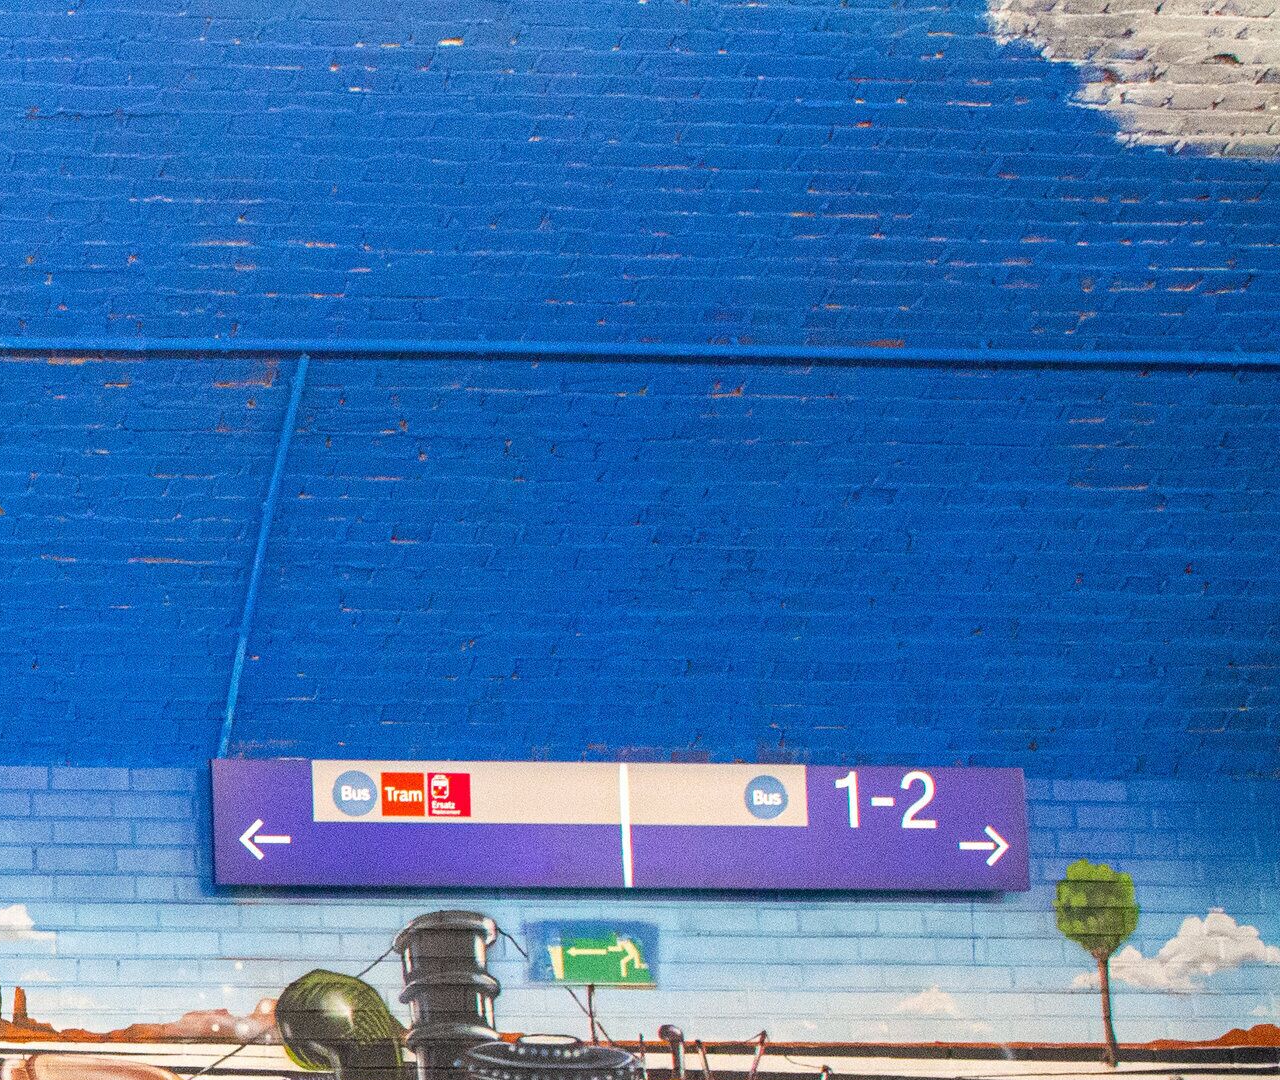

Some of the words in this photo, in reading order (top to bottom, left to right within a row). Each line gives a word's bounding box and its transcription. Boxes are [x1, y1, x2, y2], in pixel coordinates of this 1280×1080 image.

[341, 785, 371, 801] Bus
[384, 786, 423, 802] Tram
[752, 789, 783, 806] Bus
[834, 770, 939, 829] 1-2
[431, 801, 456, 809] Ersatz
